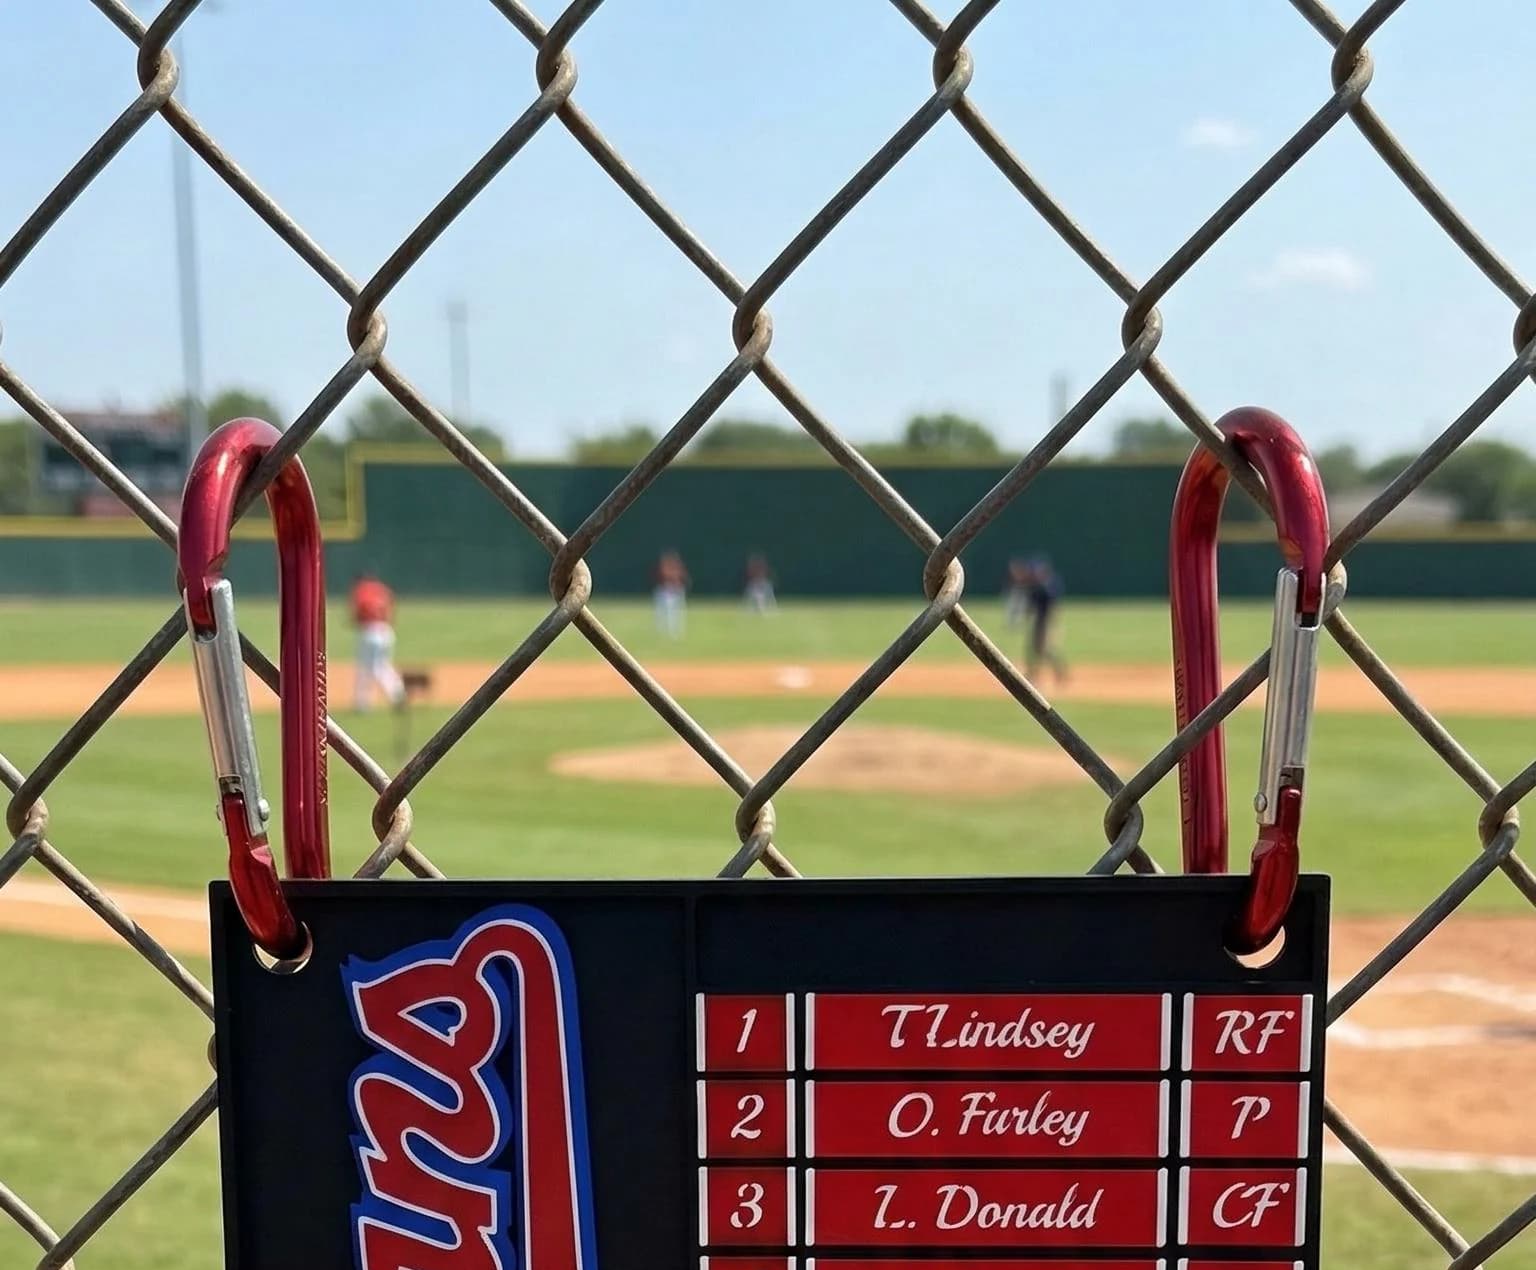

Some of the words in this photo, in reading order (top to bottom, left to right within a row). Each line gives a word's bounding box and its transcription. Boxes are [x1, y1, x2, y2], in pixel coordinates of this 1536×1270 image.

[737, 1008, 757, 1053] 1
[1215, 1009, 1295, 1055] RF
[730, 1094, 765, 1140] 2
[888, 1092, 939, 1138] O.
[958, 1089, 1090, 1147] Furley
[1231, 1095, 1271, 1139] P
[730, 1182, 765, 1228] 3
[874, 1184, 916, 1229] L.
[936, 1182, 1105, 1230] Donald
[1212, 1182, 1291, 1228] CF
